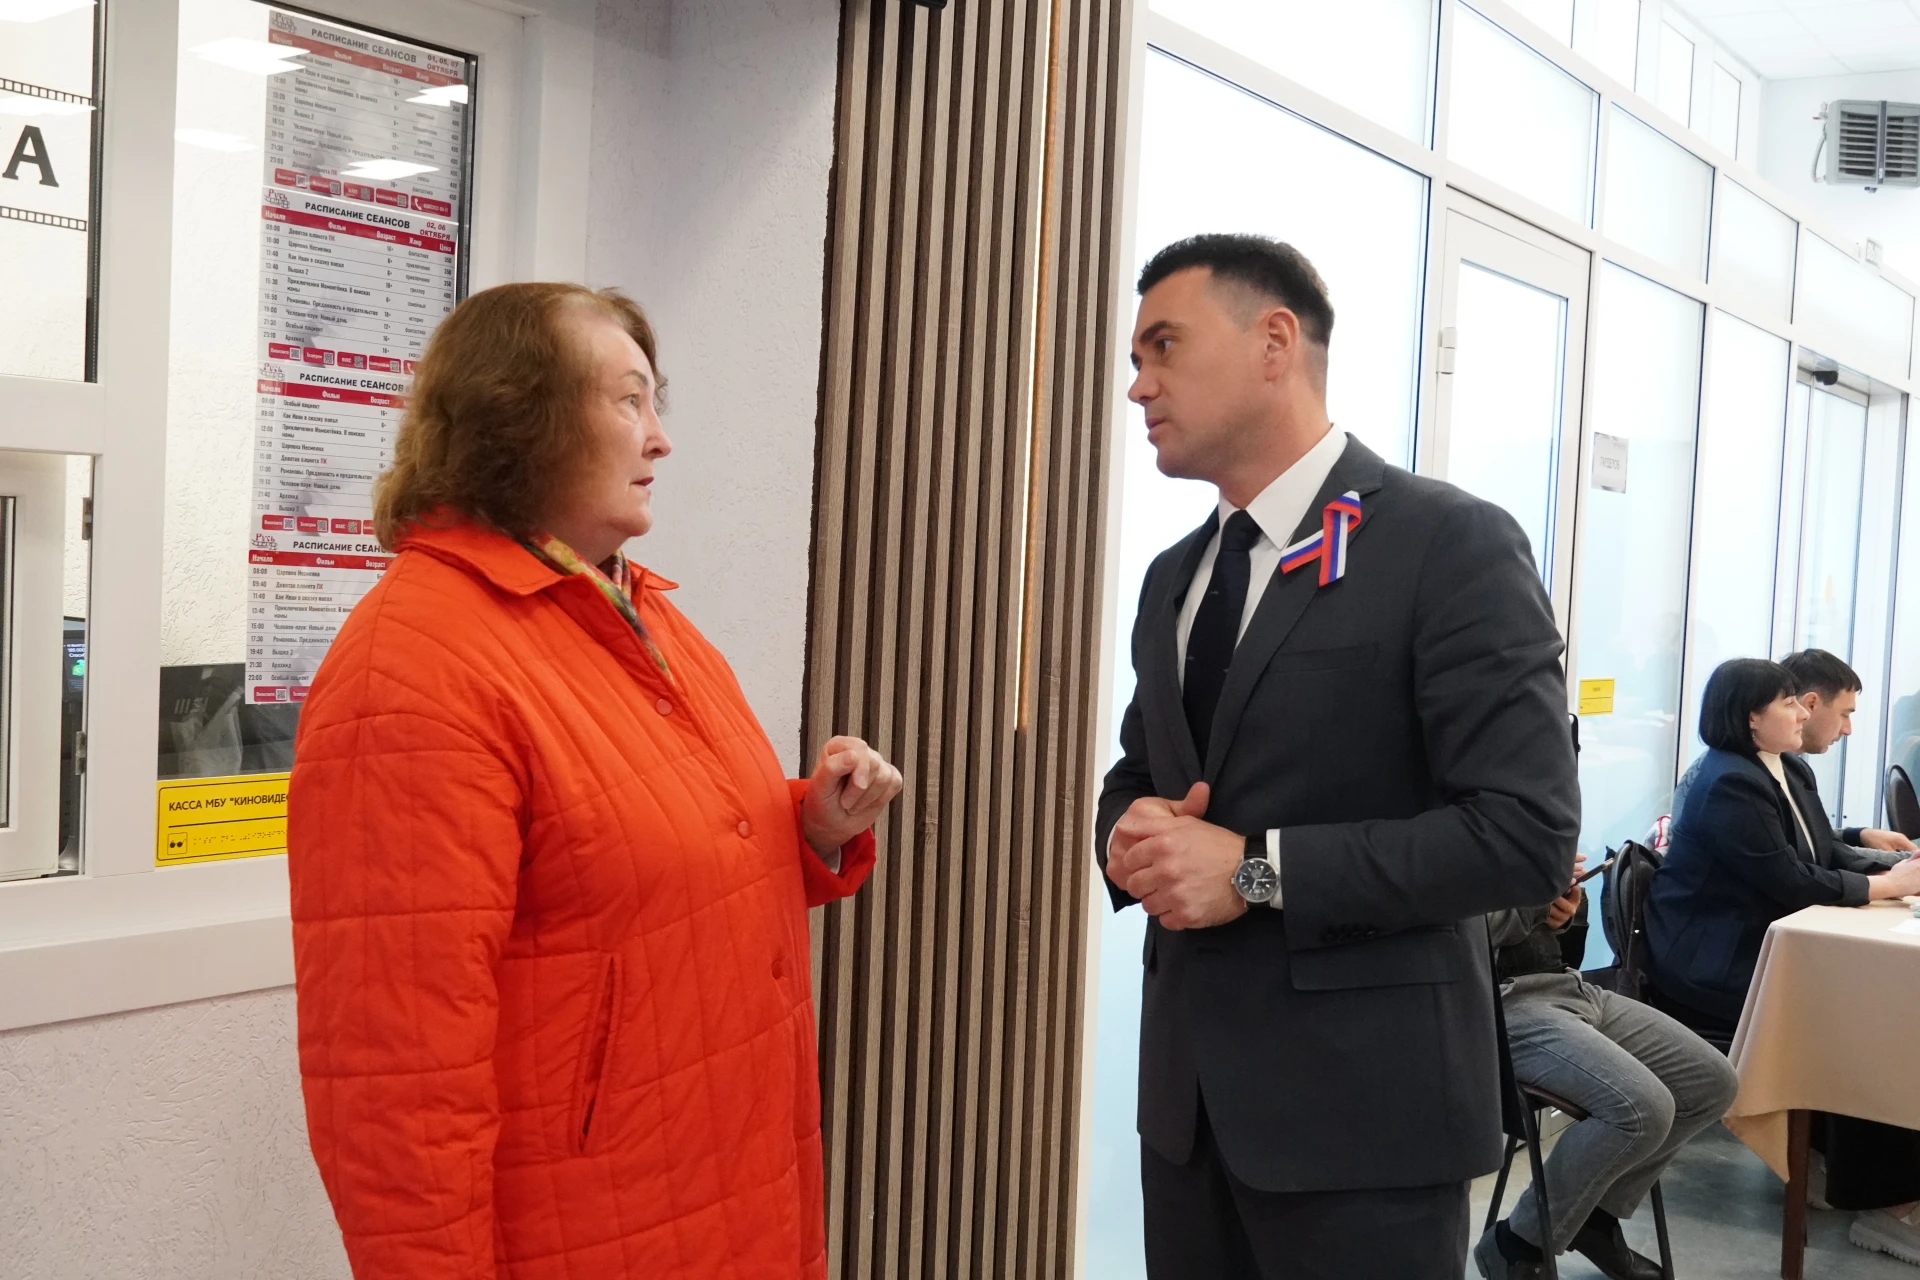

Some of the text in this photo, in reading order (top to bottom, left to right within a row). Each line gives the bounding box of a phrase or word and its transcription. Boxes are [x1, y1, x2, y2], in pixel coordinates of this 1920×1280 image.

[312, 29, 416, 63] РАСПИСАНИЕ СЕАНСОВ
[427, 64, 458, 76] ОКТЯБРЯ
[305, 202, 410, 228] РАСПИСАНИЕ СЕАНСОВ
[266, 210, 451, 252] Начало Фильм Возраст Жанр Цена
[420, 230, 450, 240] ОКТЯБРЯ
[300, 373, 357, 386] РАСПИСАНИЕ
[361, 380, 404, 392] СЕАНСОВ
[261, 384, 390, 405] Начало Фильм Возраст
[293, 541, 385, 553] РАСПИСАНИЕ СЕАН
[252, 554, 386, 568] Начало Фильм Возраст
[169, 794, 288, 811] КАССА МБУ "КИНОВИДЕ
